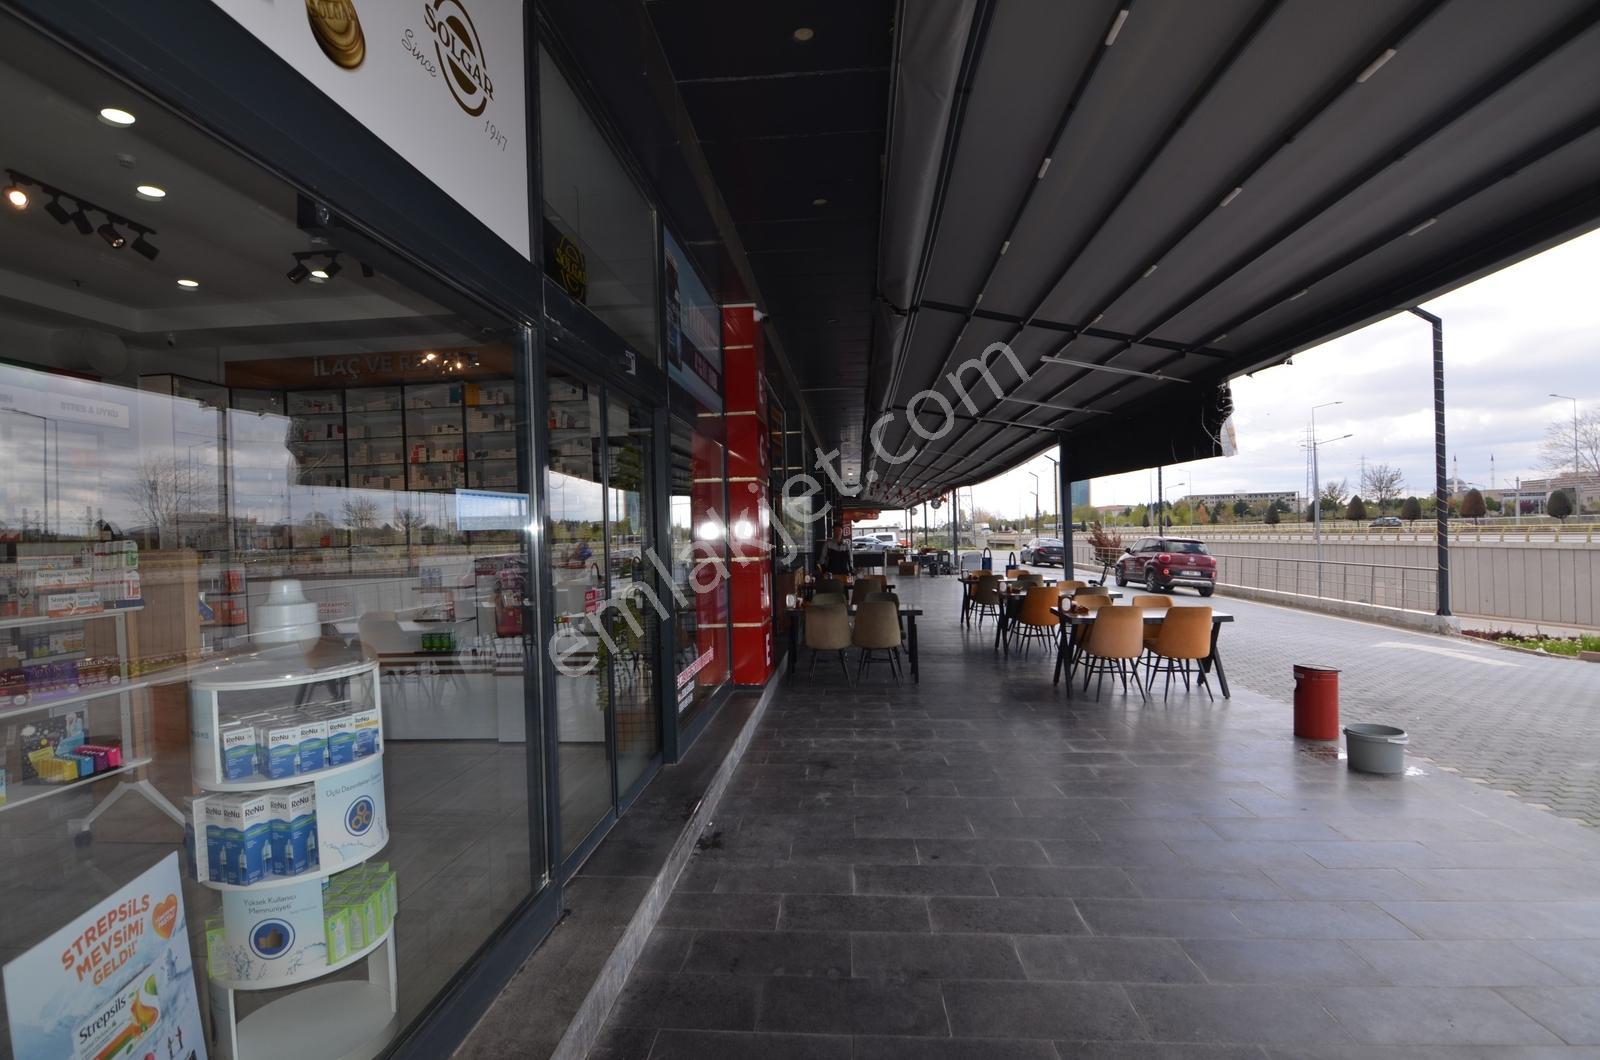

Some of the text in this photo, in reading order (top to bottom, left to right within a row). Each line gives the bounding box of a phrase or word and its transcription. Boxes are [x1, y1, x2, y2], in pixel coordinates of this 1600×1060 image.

[401, 28, 437, 78] Since
[424, 3, 494, 101] SOLGAR
[484, 119, 508, 152] 1947
[313, 356, 361, 379] İLAÇ
[365, 354, 392, 373] VE
[329, 722, 346, 731] ReNu
[301, 728, 318, 736] ReNu
[226, 735, 245, 744] ReNu
[271, 734, 289, 743] ReNu
[270, 801, 287, 810] ReNu
[291, 796, 309, 808] ReNu
[206, 807, 222, 816] ReNu
[223, 809, 240, 818] ReNu
[245, 805, 265, 817] ReNu
[79, 996, 127, 1044] Strepsils
